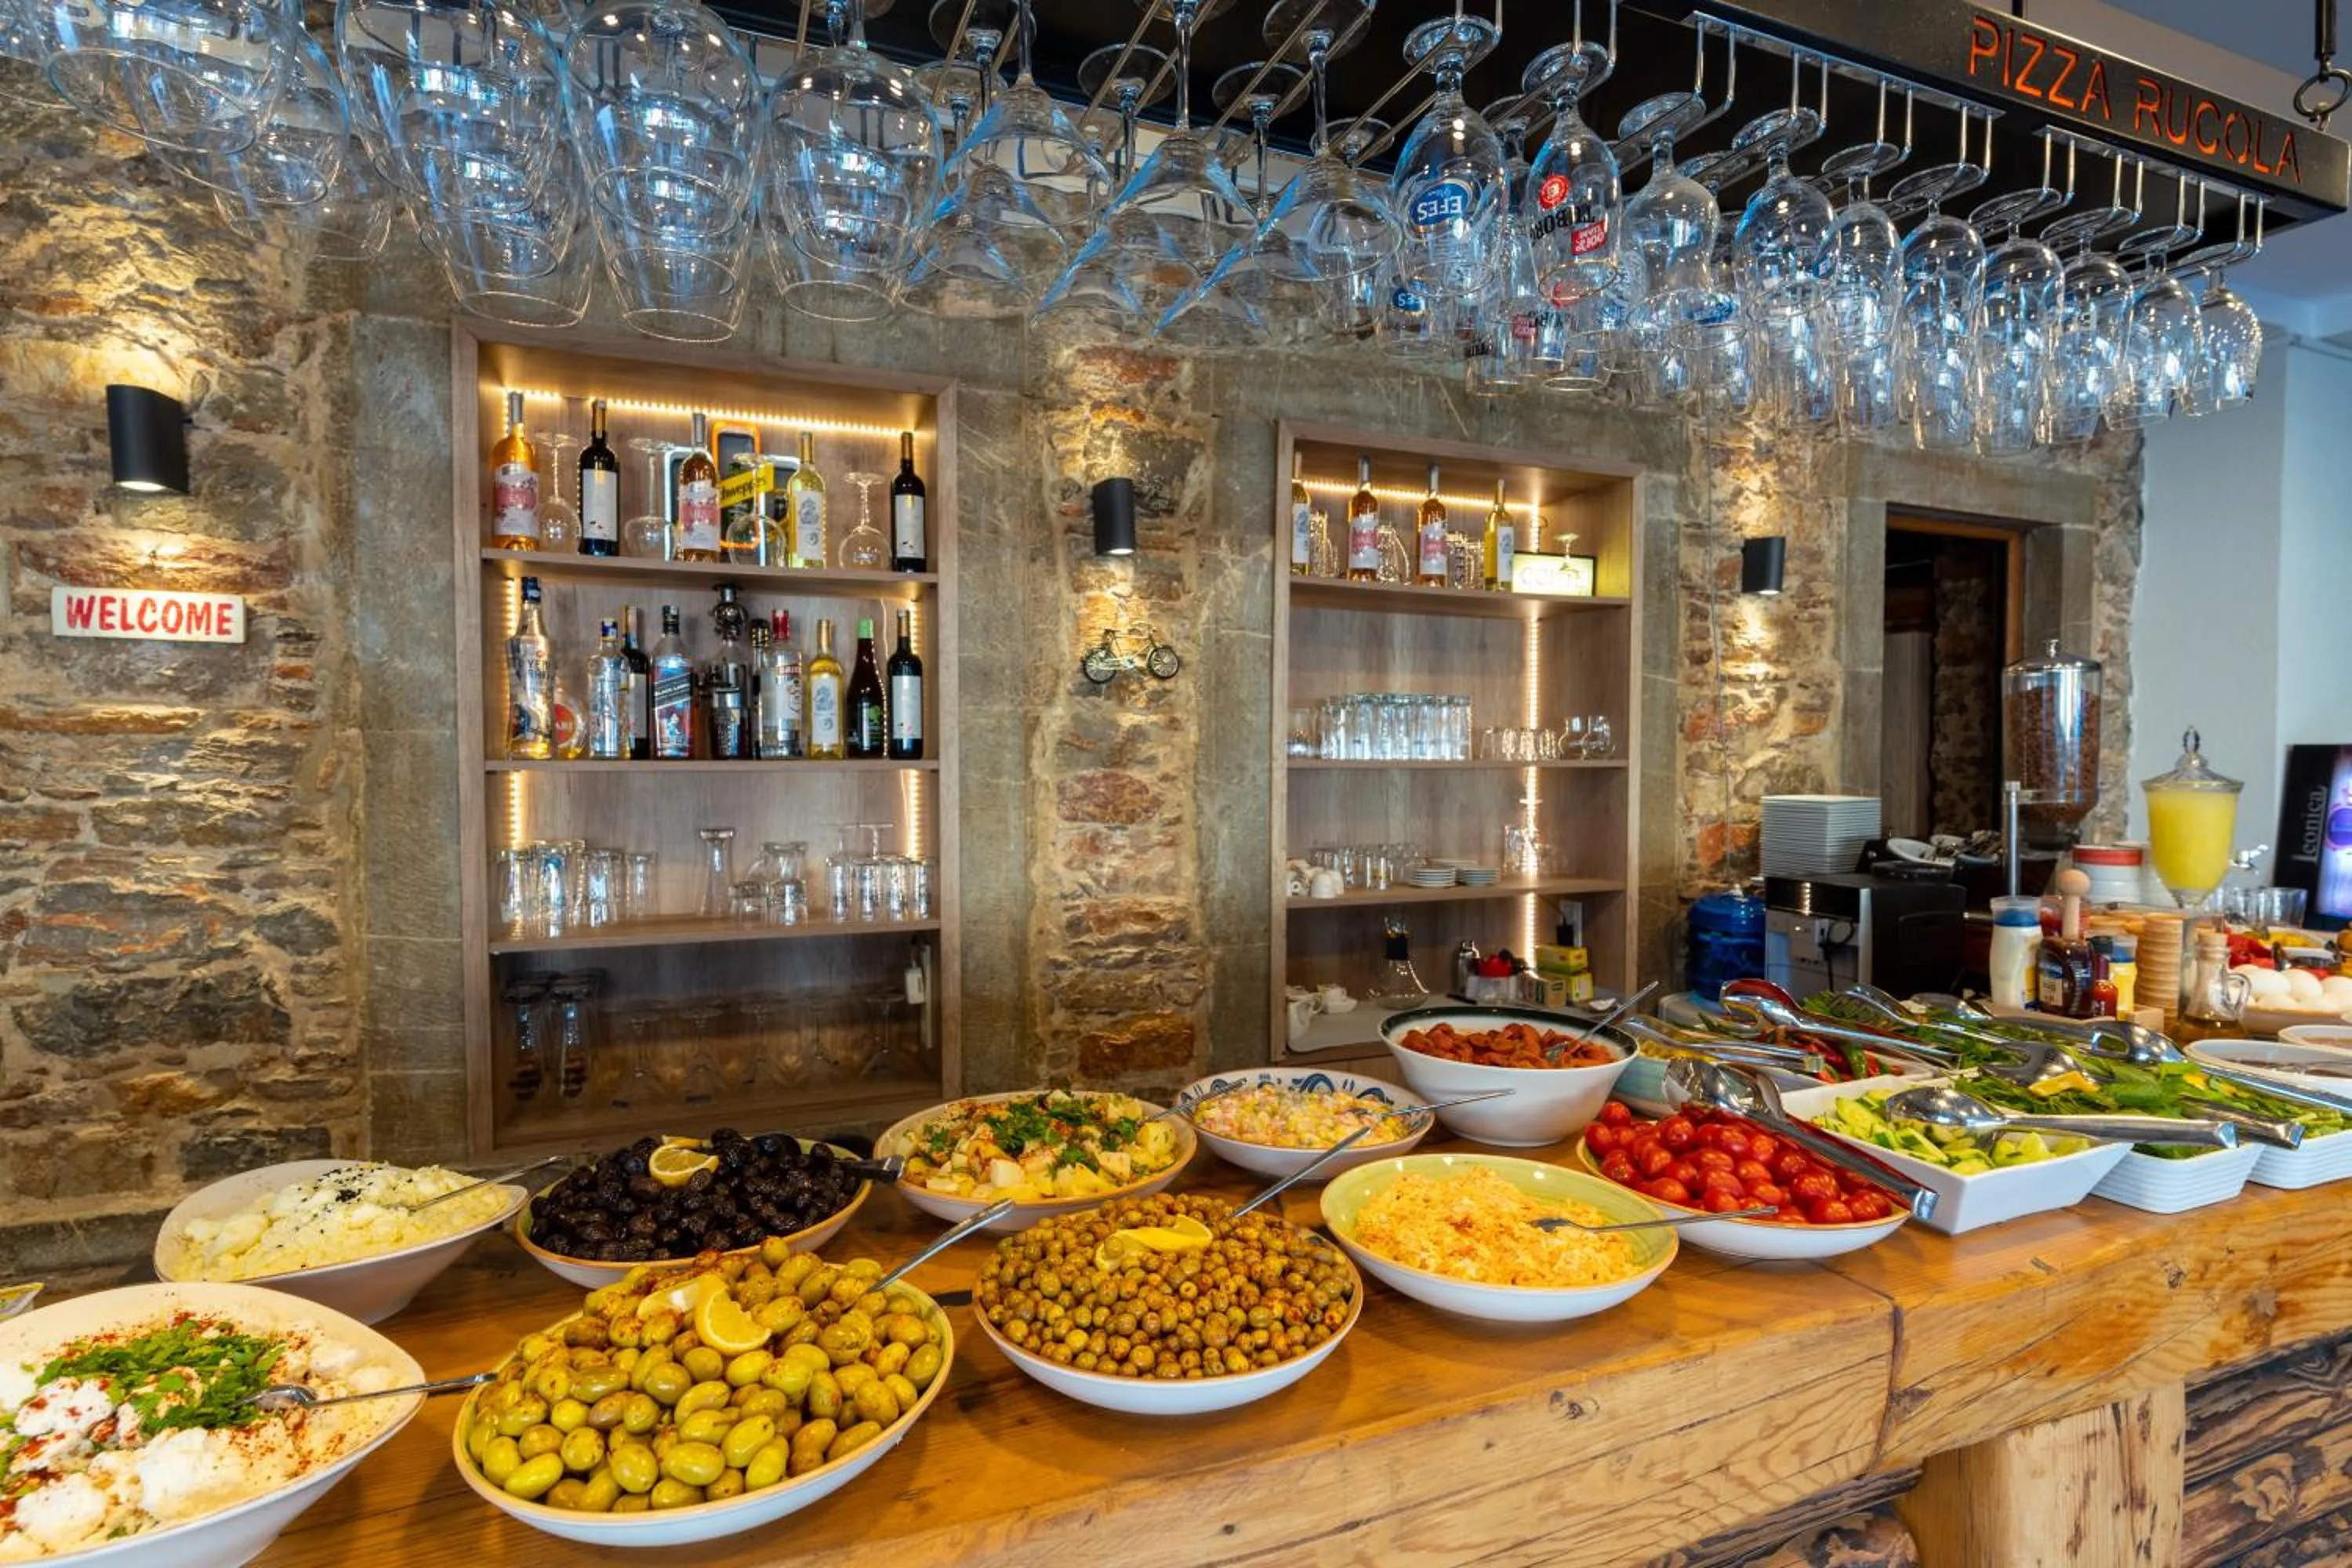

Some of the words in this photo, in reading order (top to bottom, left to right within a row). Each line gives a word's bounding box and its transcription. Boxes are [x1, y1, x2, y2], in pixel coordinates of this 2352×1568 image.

[1969, 14, 2113, 122] PIZZA
[2134, 78, 2302, 185] RUCOLA
[1417, 195, 1462, 220] EFES
[65, 594, 234, 636] WELCOME
